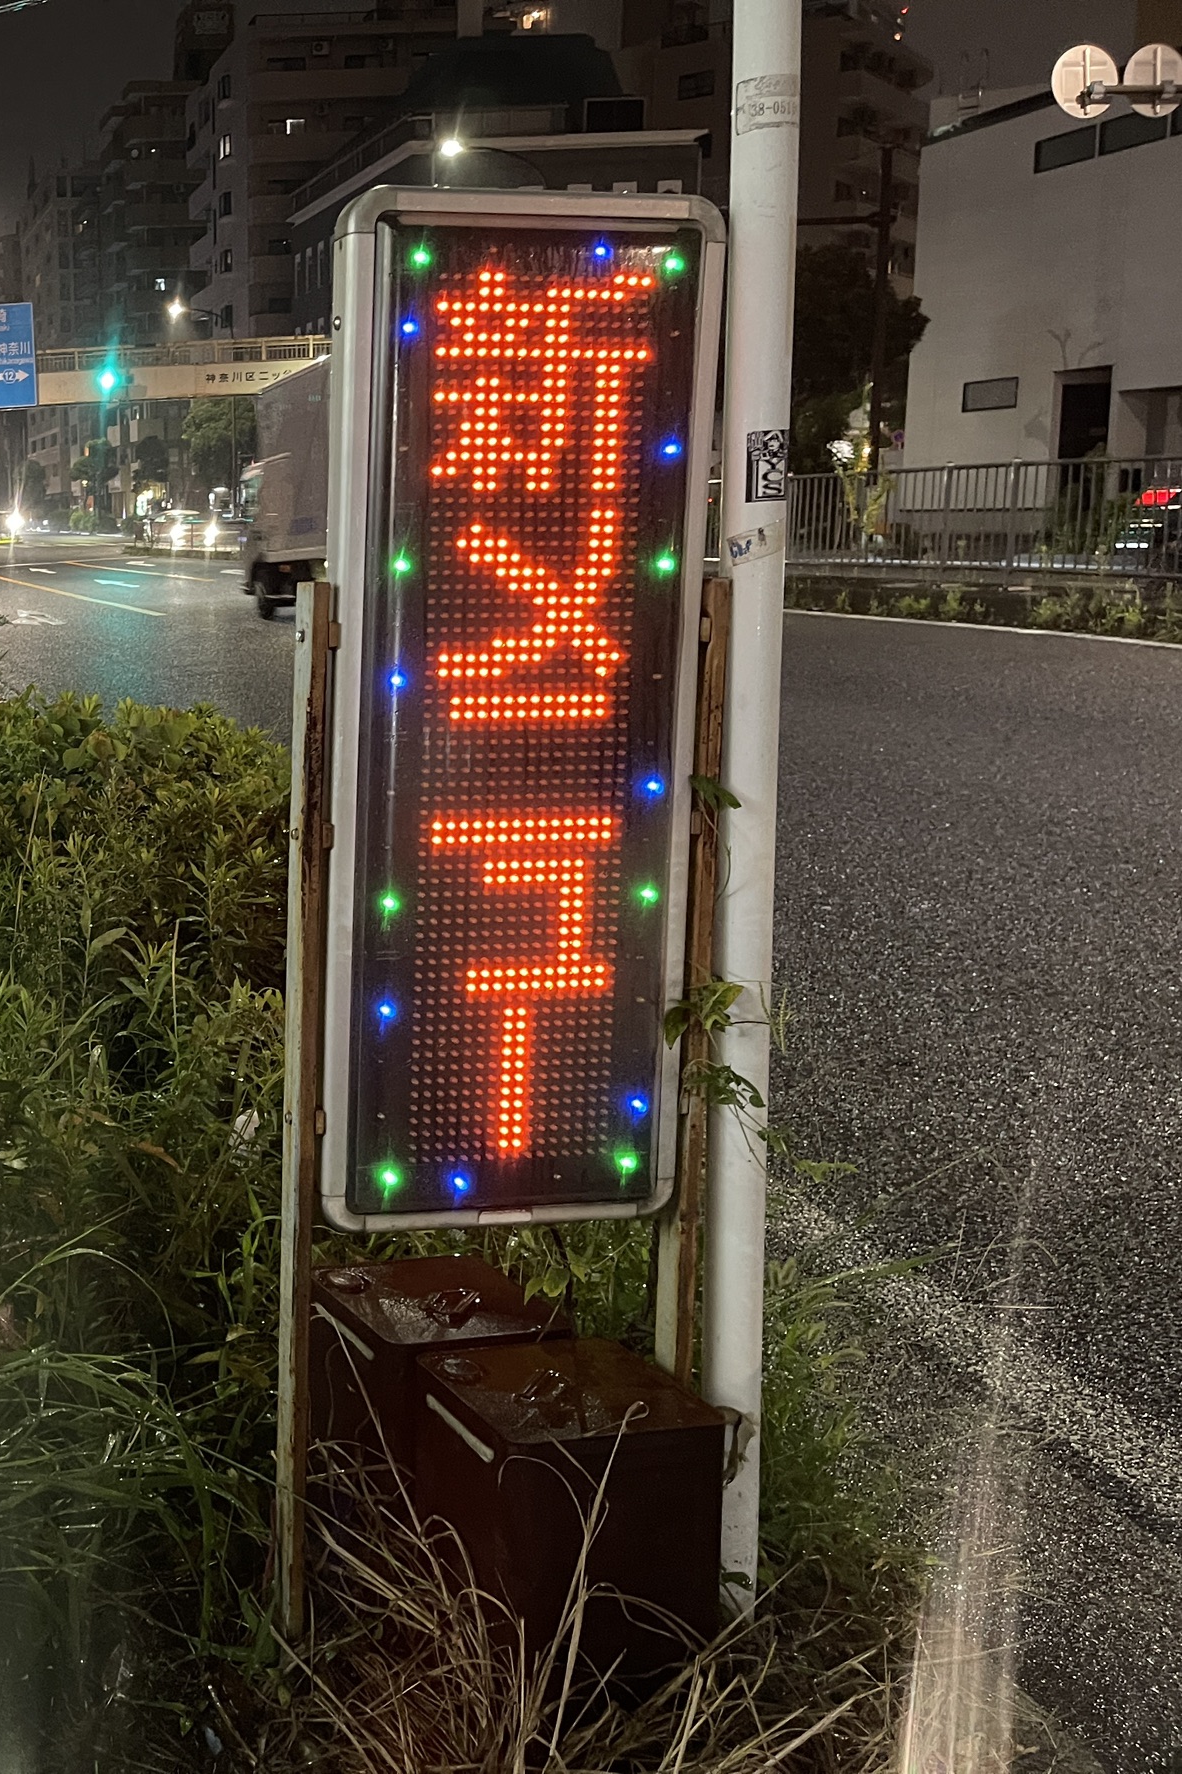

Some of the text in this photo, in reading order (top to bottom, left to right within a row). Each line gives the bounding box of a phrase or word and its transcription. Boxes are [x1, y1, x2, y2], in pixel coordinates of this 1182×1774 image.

[4, 372, 16, 381] 12
[429, 266, 656, 1154] 新メニュー
